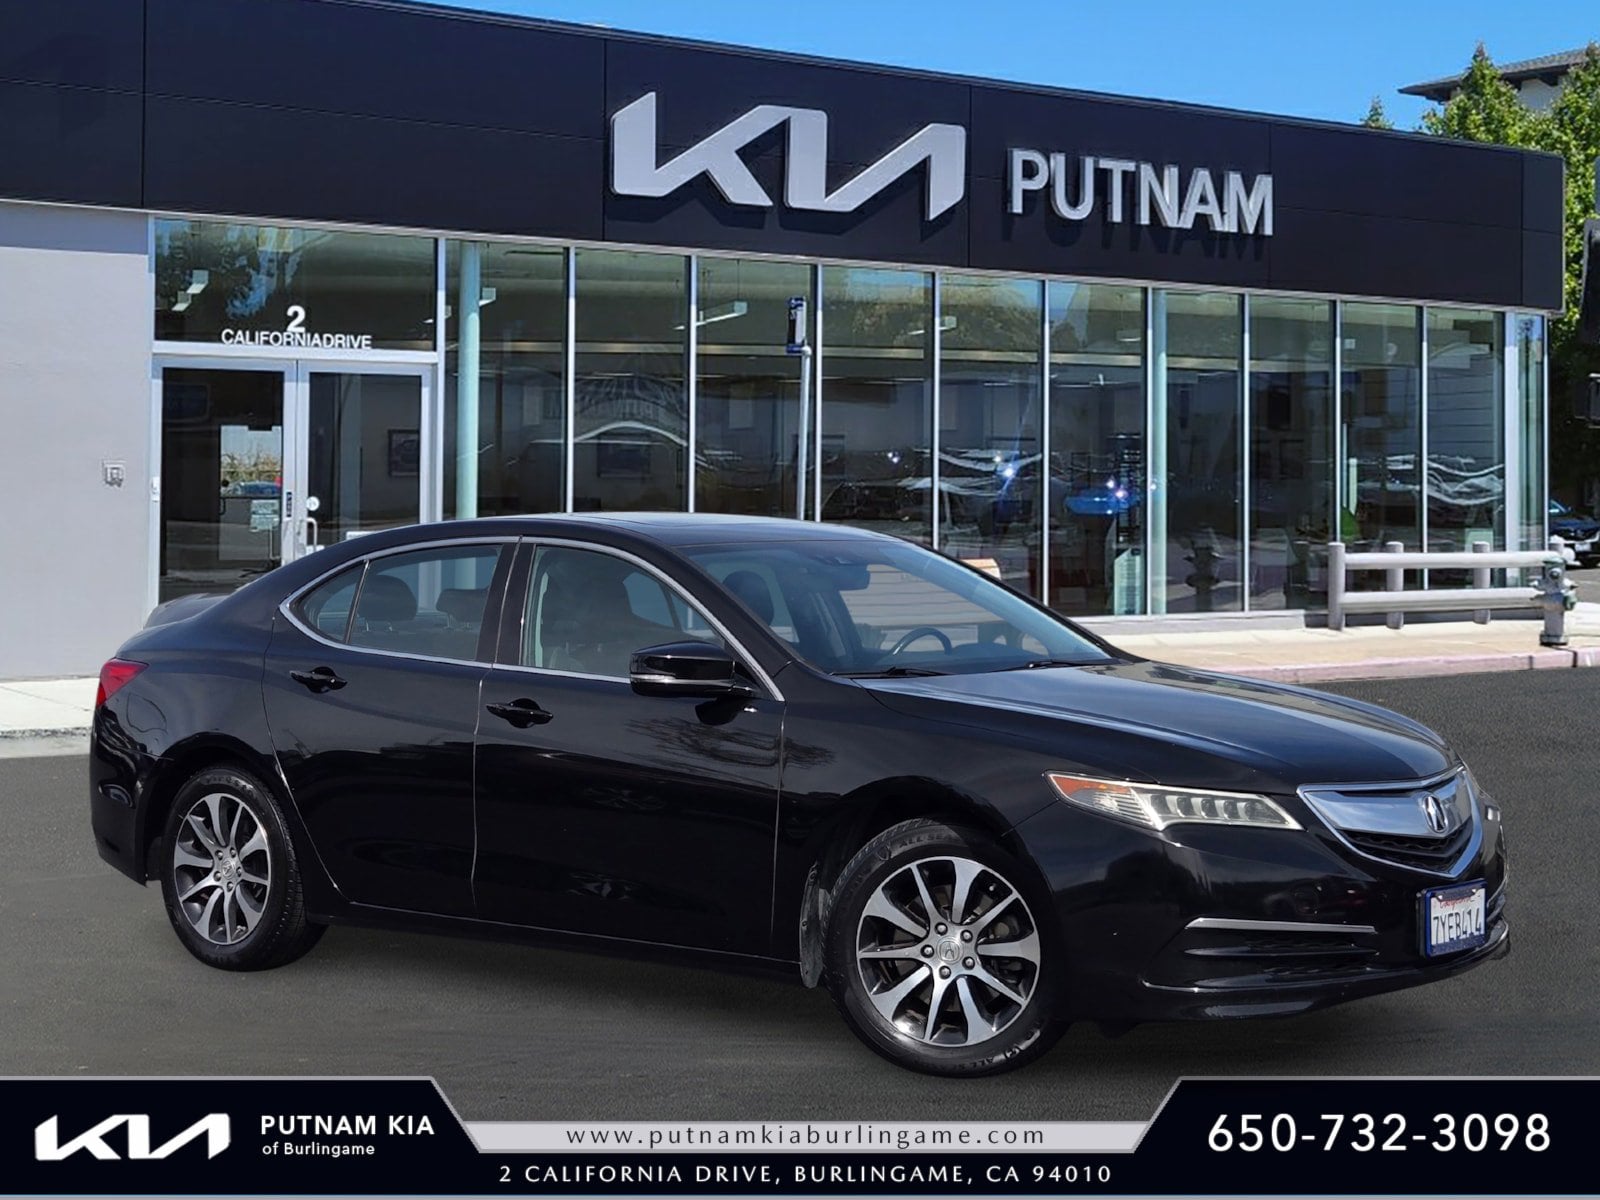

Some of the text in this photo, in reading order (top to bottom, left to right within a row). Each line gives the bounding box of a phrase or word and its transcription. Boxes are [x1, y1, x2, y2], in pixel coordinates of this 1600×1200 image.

[610, 91, 967, 221] KIA
[1008, 147, 1274, 236] PUTNAM
[286, 305, 306, 332] 2
[1433, 907, 1482, 945] 7YEB414
